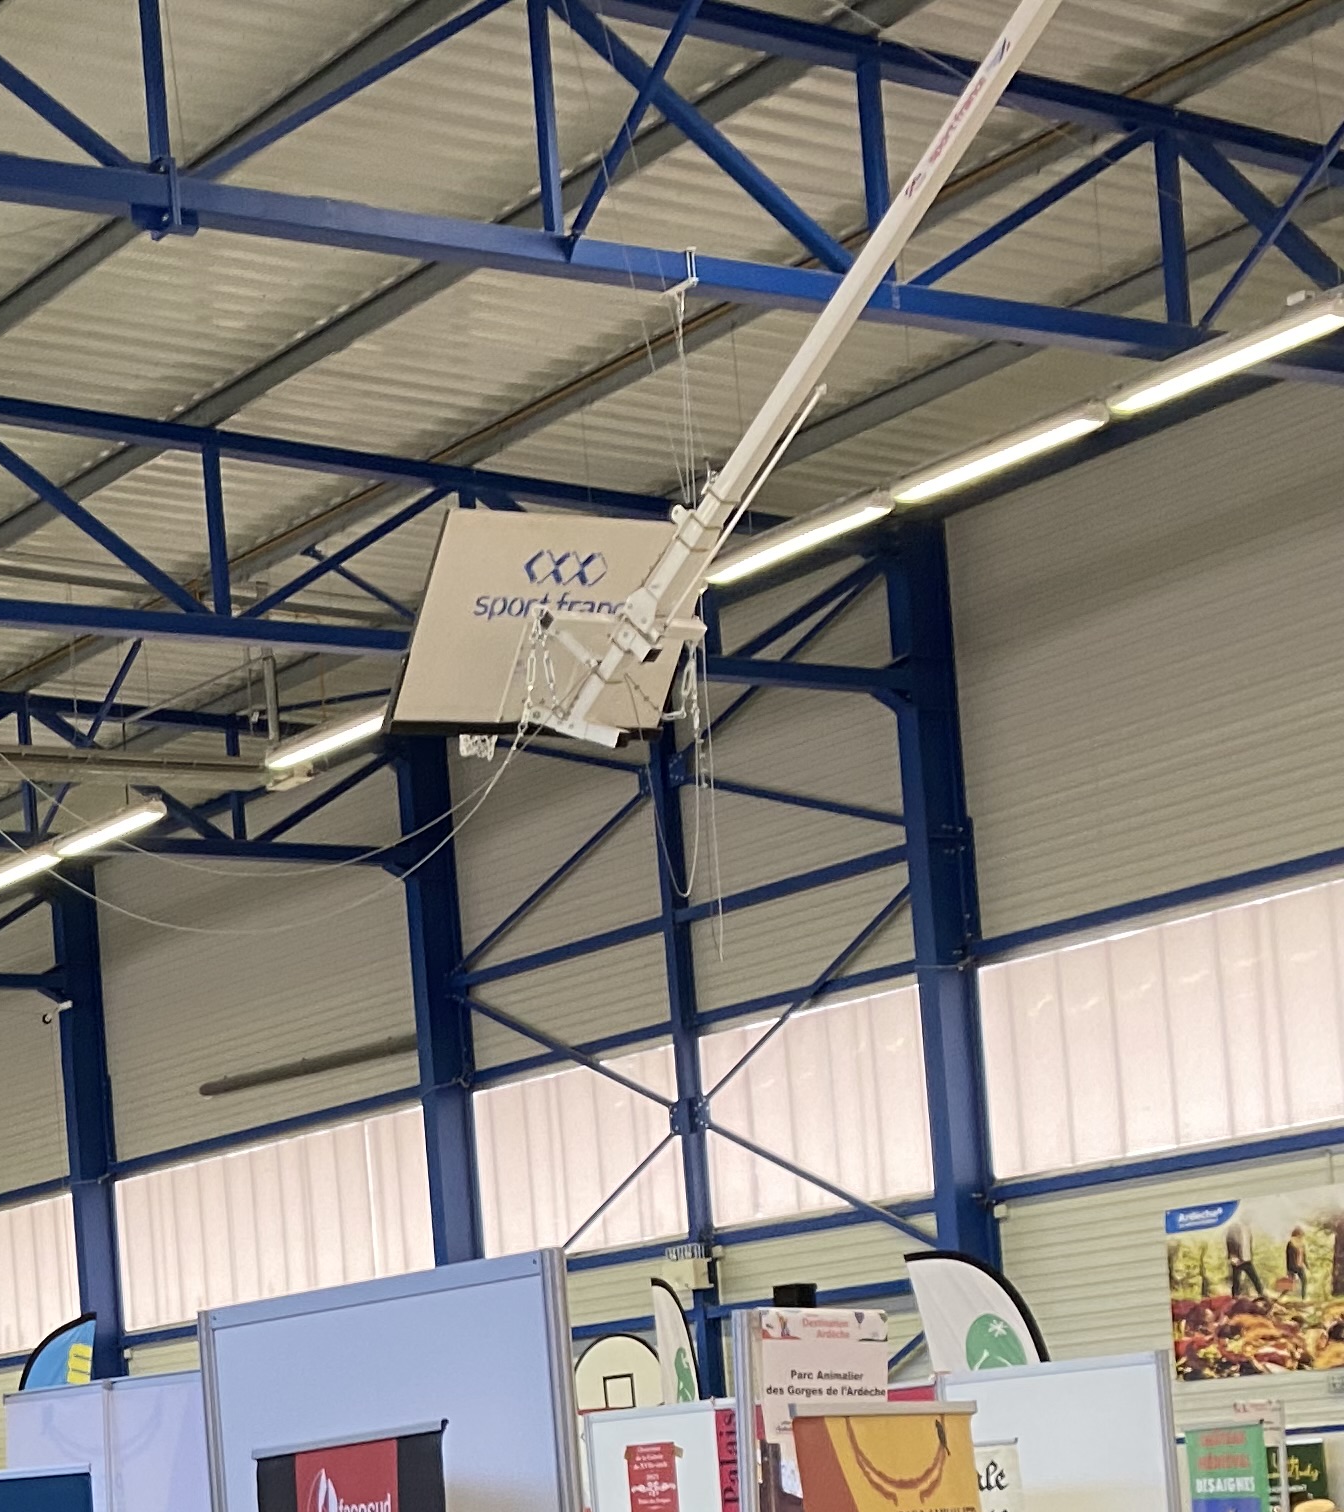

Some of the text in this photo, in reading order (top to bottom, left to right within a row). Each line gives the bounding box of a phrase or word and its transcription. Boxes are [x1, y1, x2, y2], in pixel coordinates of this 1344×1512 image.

[556, 591, 626, 616] franc
[790, 1370, 864, 1380] Parc Animalier
[766, 1385, 784, 1396] des
[787, 1385, 823, 1398] Gorges
[826, 1385, 839, 1396] de
